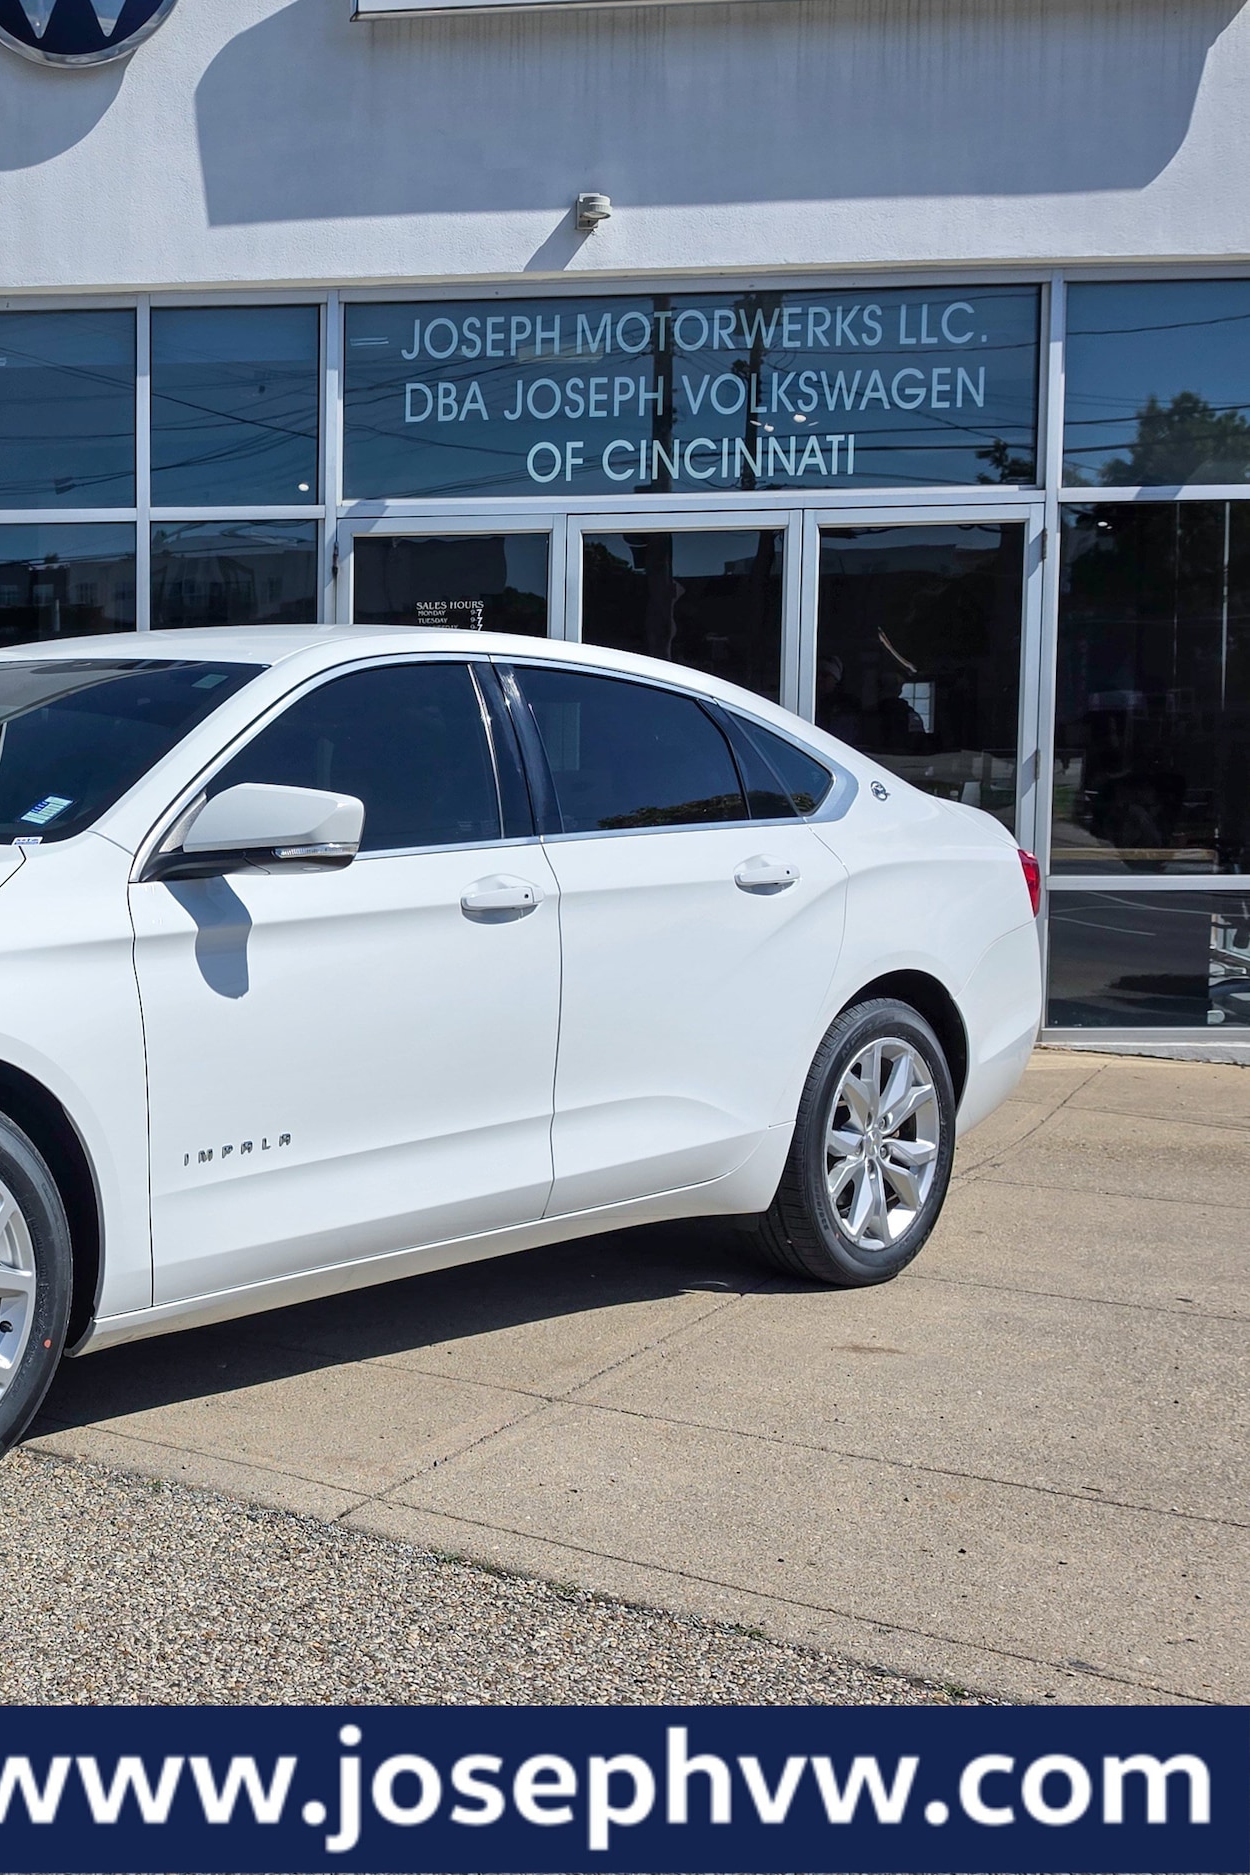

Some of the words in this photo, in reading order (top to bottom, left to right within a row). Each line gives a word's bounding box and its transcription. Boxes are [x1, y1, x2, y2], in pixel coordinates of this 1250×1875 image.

[401, 314, 561, 361] JOSEPH
[576, 304, 883, 354] MOTORWERKS
[899, 301, 988, 346] LLC.
[404, 382, 489, 423] DBA
[503, 375, 664, 420] JOSEPH
[681, 366, 986, 417] VOLKSWAGEN
[526, 441, 585, 483] OF
[602, 434, 855, 480] CINCINNATI
[416, 602, 447, 610] SALES
[450, 600, 484, 610] HOURS
[184, 1133, 291, 1166] IMPALA
